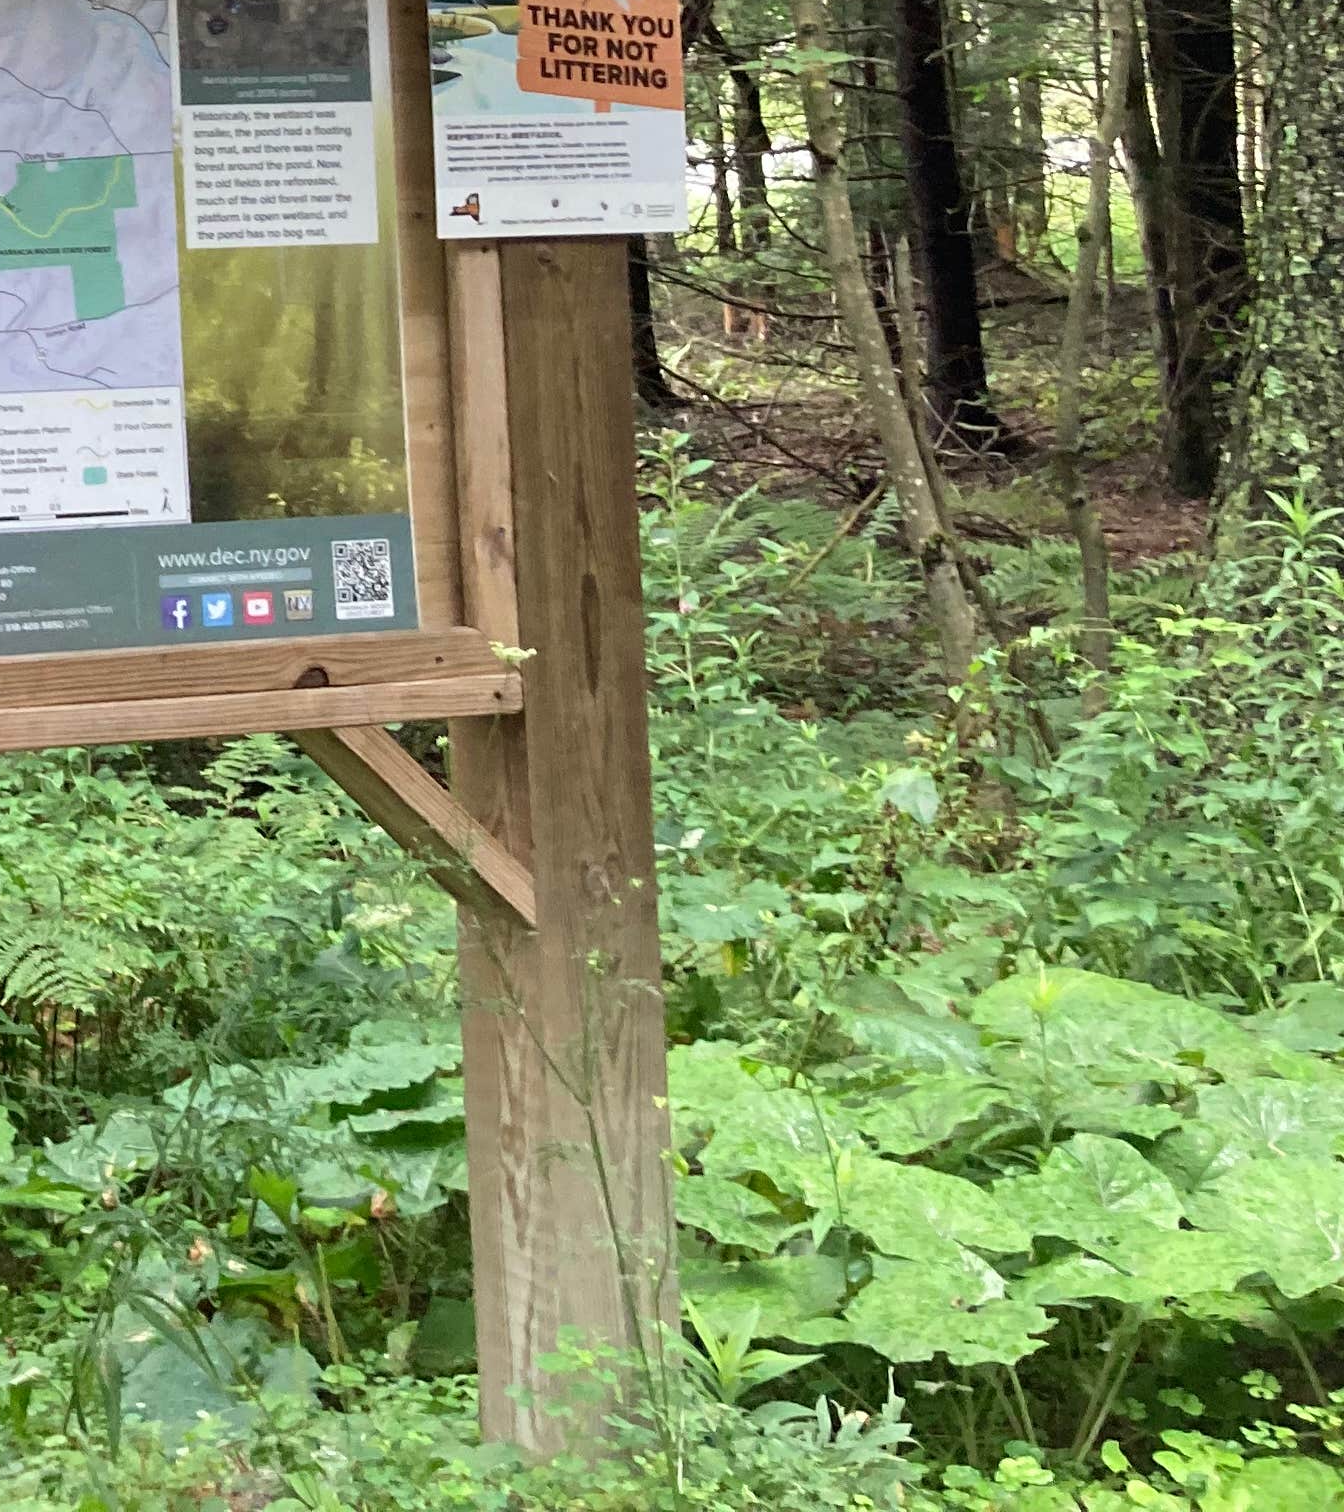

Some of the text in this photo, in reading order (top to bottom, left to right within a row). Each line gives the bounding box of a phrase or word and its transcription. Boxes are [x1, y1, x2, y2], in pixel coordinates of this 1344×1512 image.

[528, 5, 673, 38] THANK YOU
[548, 32, 657, 62] FOR NOT
[541, 57, 667, 89] LITTERING
[158, 546, 311, 568] www.dec.ny.gov
